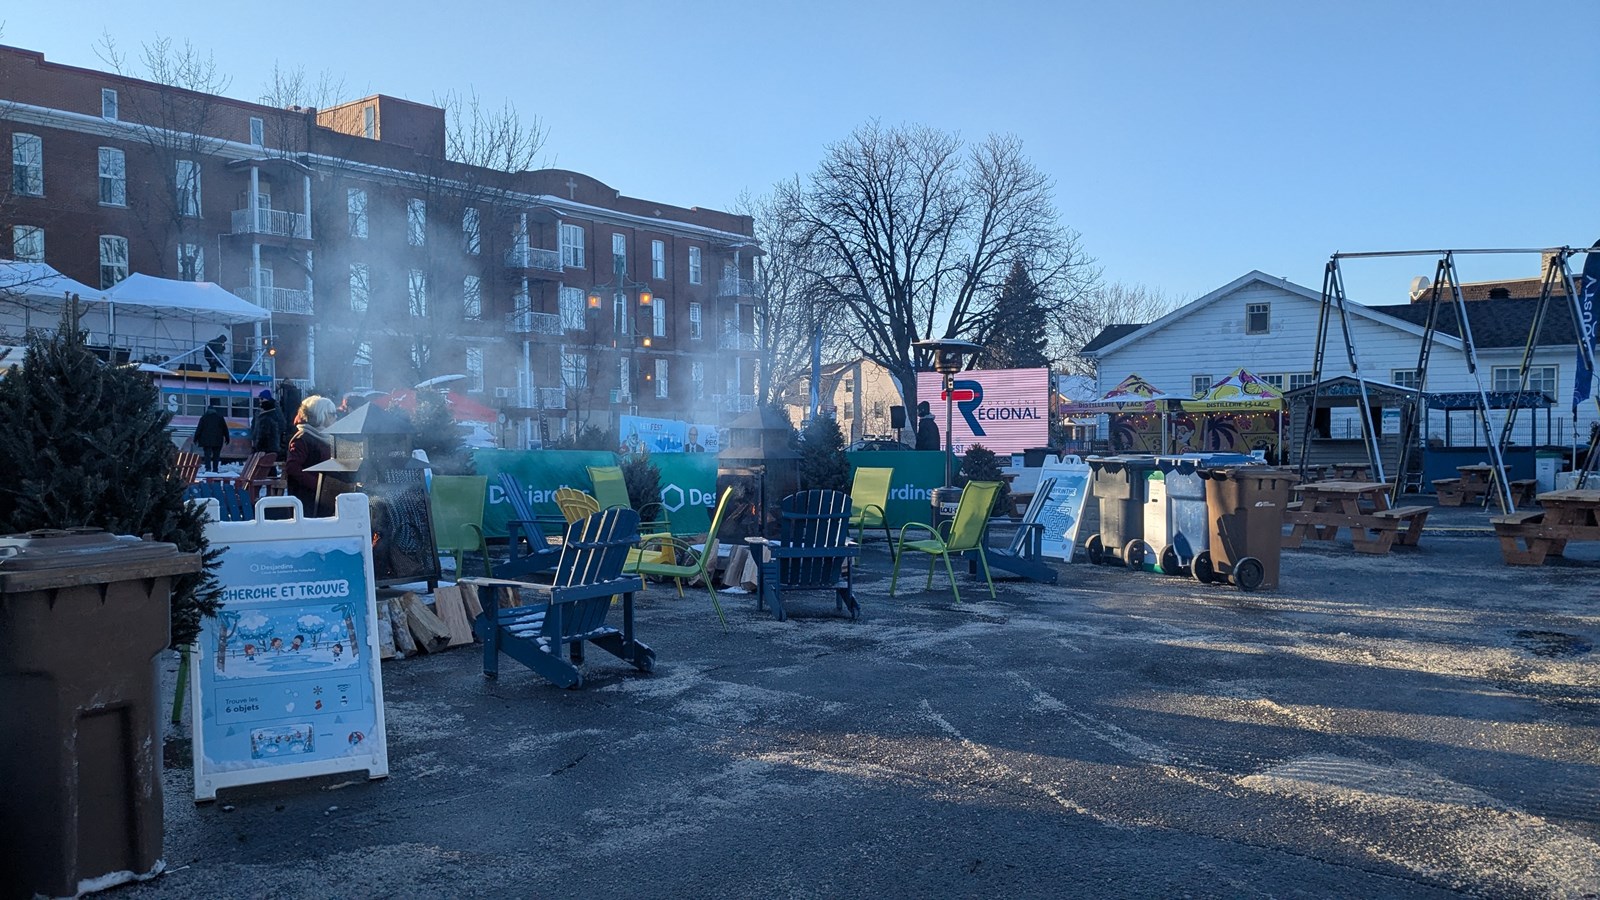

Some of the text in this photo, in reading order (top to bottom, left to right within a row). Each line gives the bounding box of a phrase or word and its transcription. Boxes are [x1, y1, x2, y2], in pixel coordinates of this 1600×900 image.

[261, 563, 293, 571] Desjardins
[220, 582, 346, 601] CHERCHE ET TROUVE
[233, 704, 260, 713] objets
